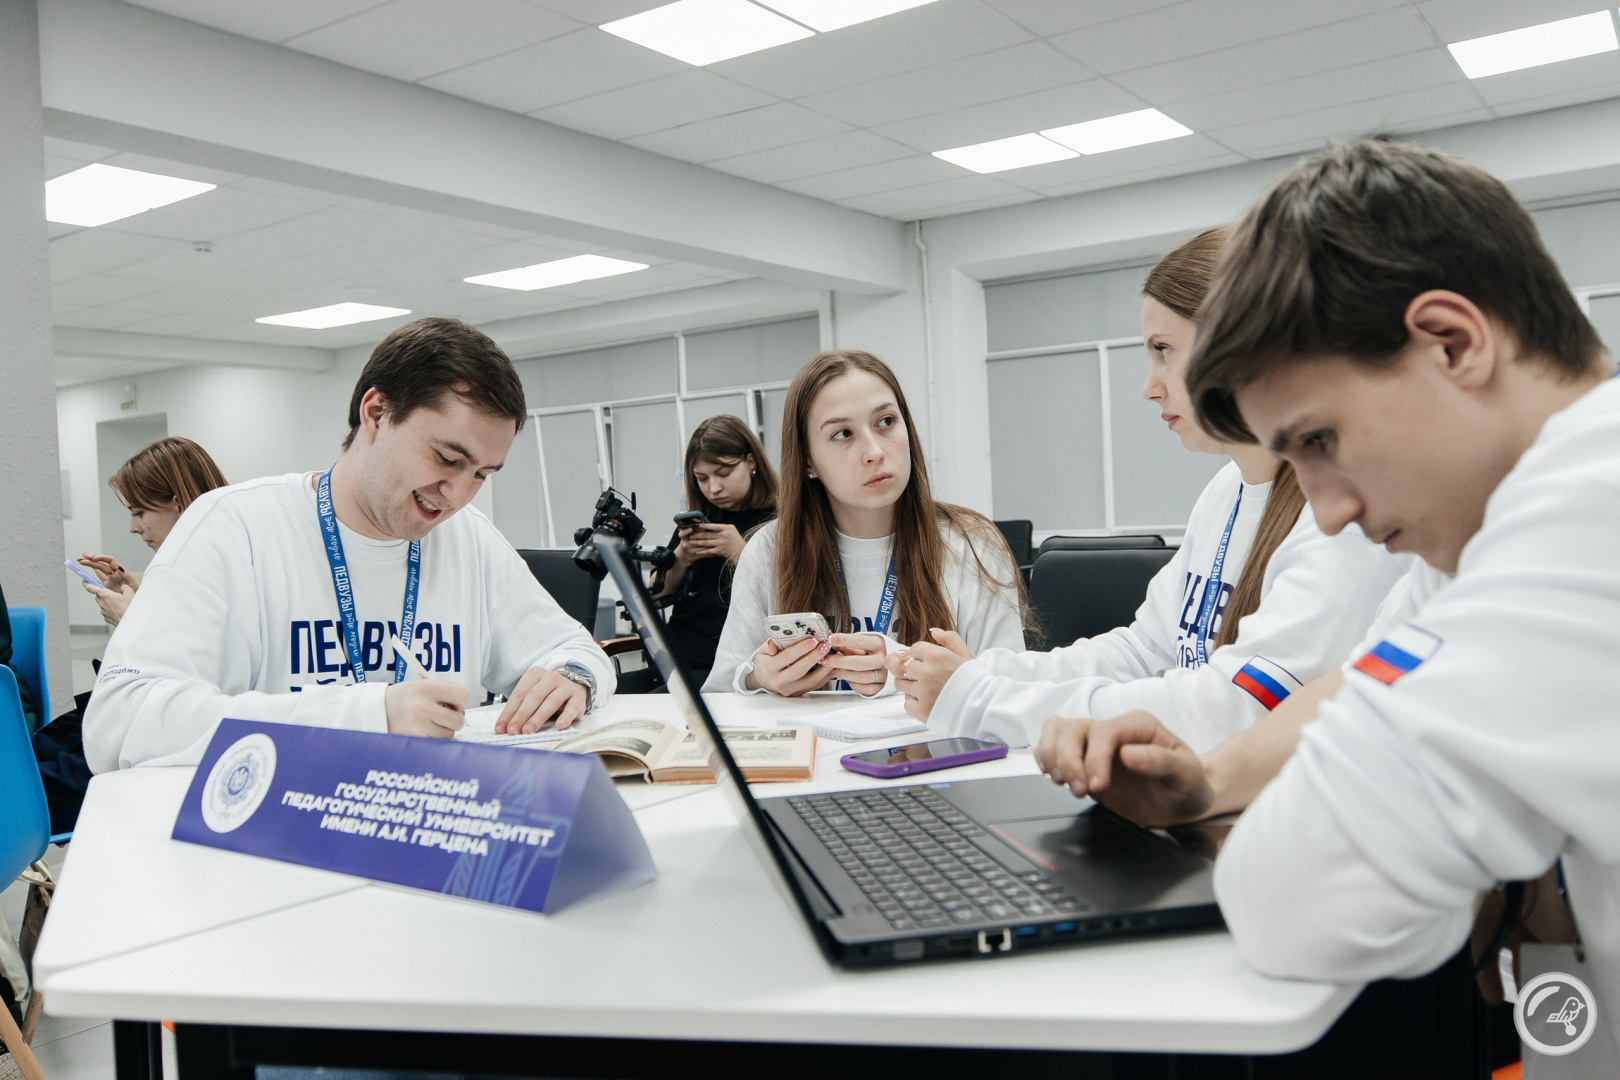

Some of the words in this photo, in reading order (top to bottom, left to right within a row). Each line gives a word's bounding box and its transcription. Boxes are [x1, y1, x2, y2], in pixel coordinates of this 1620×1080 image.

[1210, 532, 1230, 582] ПЕДВУЗЫ
[319, 476, 332, 517] ПЕДВУЗЫ
[334, 565, 353, 612] ПЕДВУЗЫ
[354, 661, 365, 683] ПЕД
[400, 611, 414, 650] ДВУЗЫ
[334, 782, 501, 820] ГОСУДАРСТВЕННЫЙ
[364, 769, 480, 799] РОССИЙСКИЙ
[281, 790, 424, 827] ПЕДАГОГИЧЕСКИЙ
[423, 811, 556, 847] УНИВЕРСИТЕТ
[320, 814, 378, 837] ИМЕНИ
[376, 823, 408, 842] А.И.
[410, 828, 488, 857] ГЕРЦЕНА
